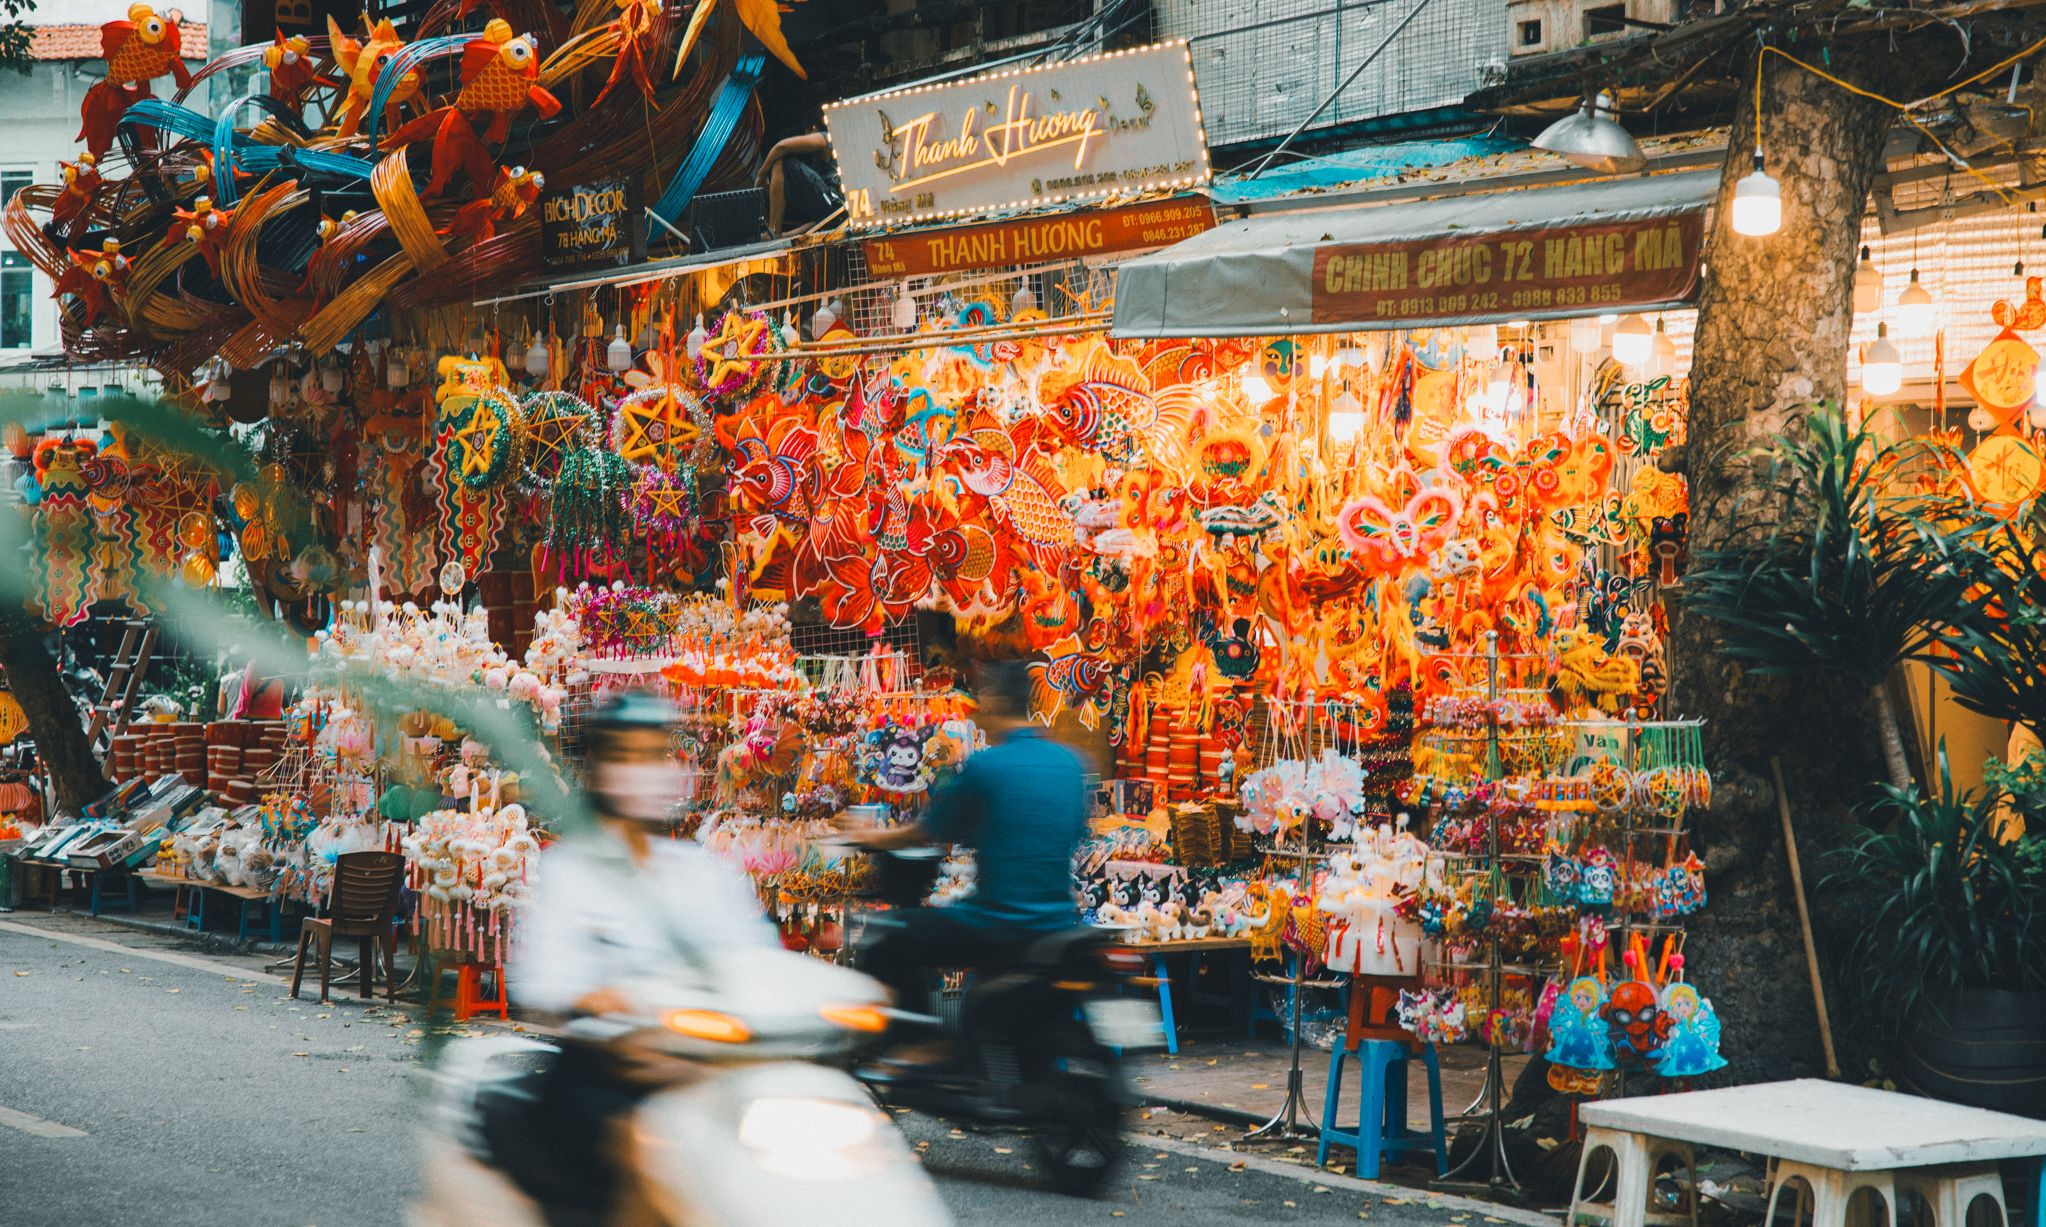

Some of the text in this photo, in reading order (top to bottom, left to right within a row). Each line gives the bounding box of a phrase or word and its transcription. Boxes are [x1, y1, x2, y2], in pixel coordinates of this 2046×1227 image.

[892, 84, 1098, 180] Thanh Hương
[849, 188, 873, 219] 74
[1139, 205, 1202, 225] 0966.909.205
[558, 232, 569, 249] 78
[928, 219, 1103, 268] THANH HƯƠNG
[1143, 222, 1205, 242] 0846.231.287
[875, 242, 895, 262] 74
[1325, 220, 1683, 294] CHINH CHÚC 72 HÀNG MÃ
[1401, 297, 1434, 315] 0913
[1471, 292, 1498, 310] 242
[1556, 286, 1585, 304] 833
[1591, 283, 1622, 301] 855
